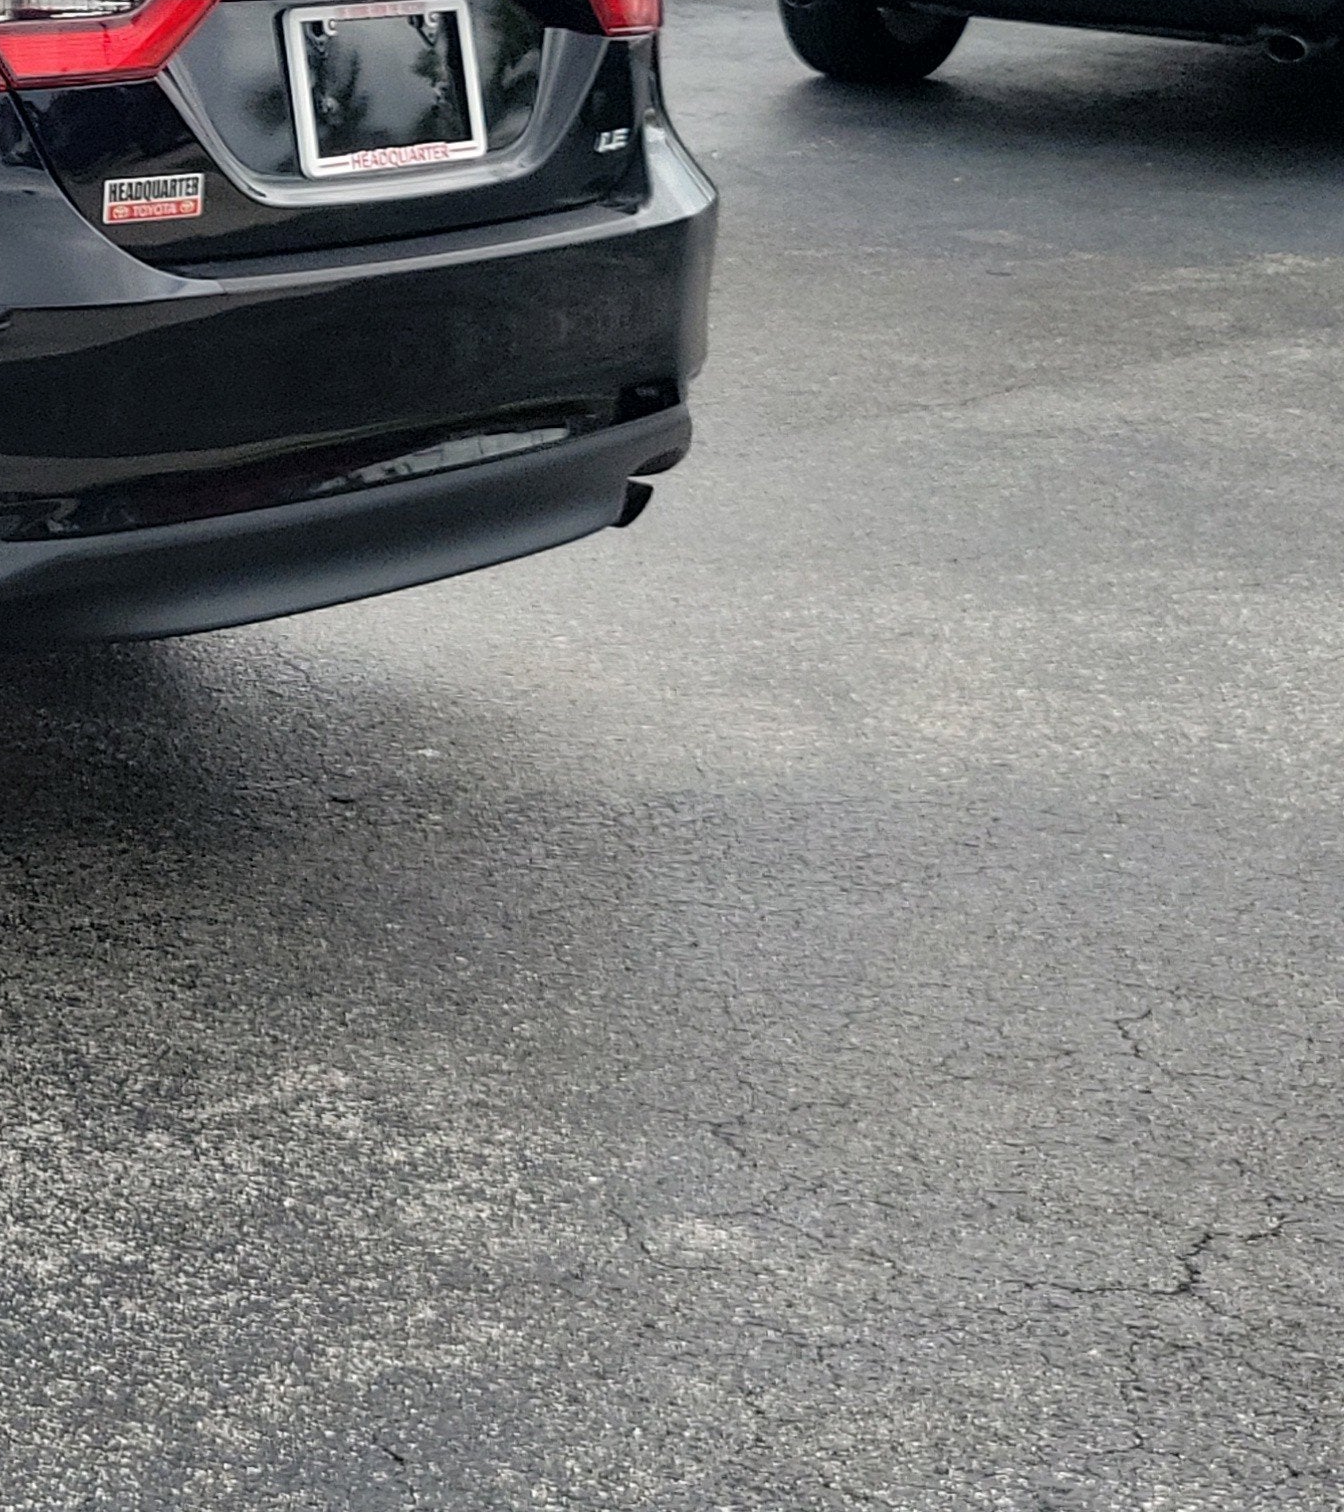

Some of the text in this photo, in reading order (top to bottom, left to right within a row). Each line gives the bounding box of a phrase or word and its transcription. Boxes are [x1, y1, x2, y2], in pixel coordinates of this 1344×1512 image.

[597, 128, 630, 153] LE
[352, 144, 450, 170] HEADQUARTER
[109, 176, 200, 202] HEADQUARTER
[132, 202, 178, 218] TOYOTA
